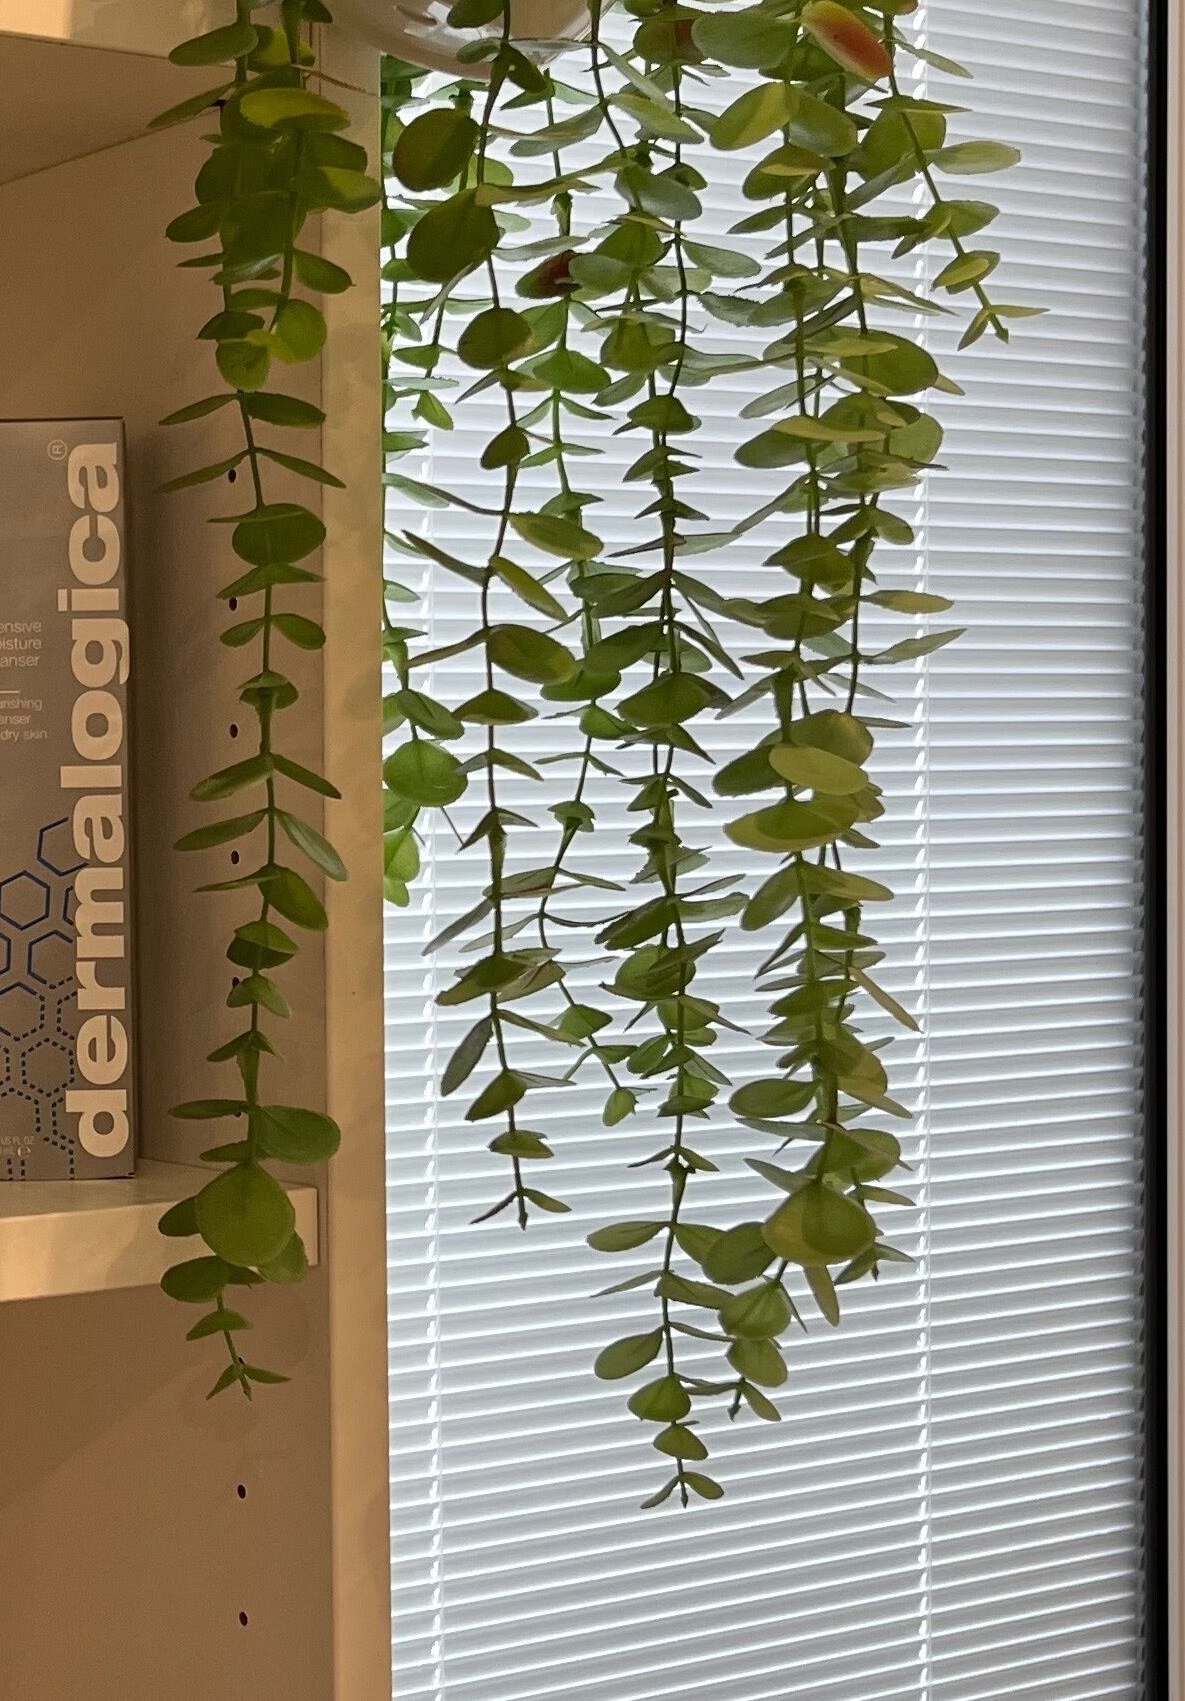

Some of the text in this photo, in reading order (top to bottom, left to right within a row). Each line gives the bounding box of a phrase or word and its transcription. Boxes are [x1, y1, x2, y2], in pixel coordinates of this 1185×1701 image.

[0, 729, 19, 742] dry
[22, 729, 48, 740] skin
[57, 442, 130, 1157] dermalogica
